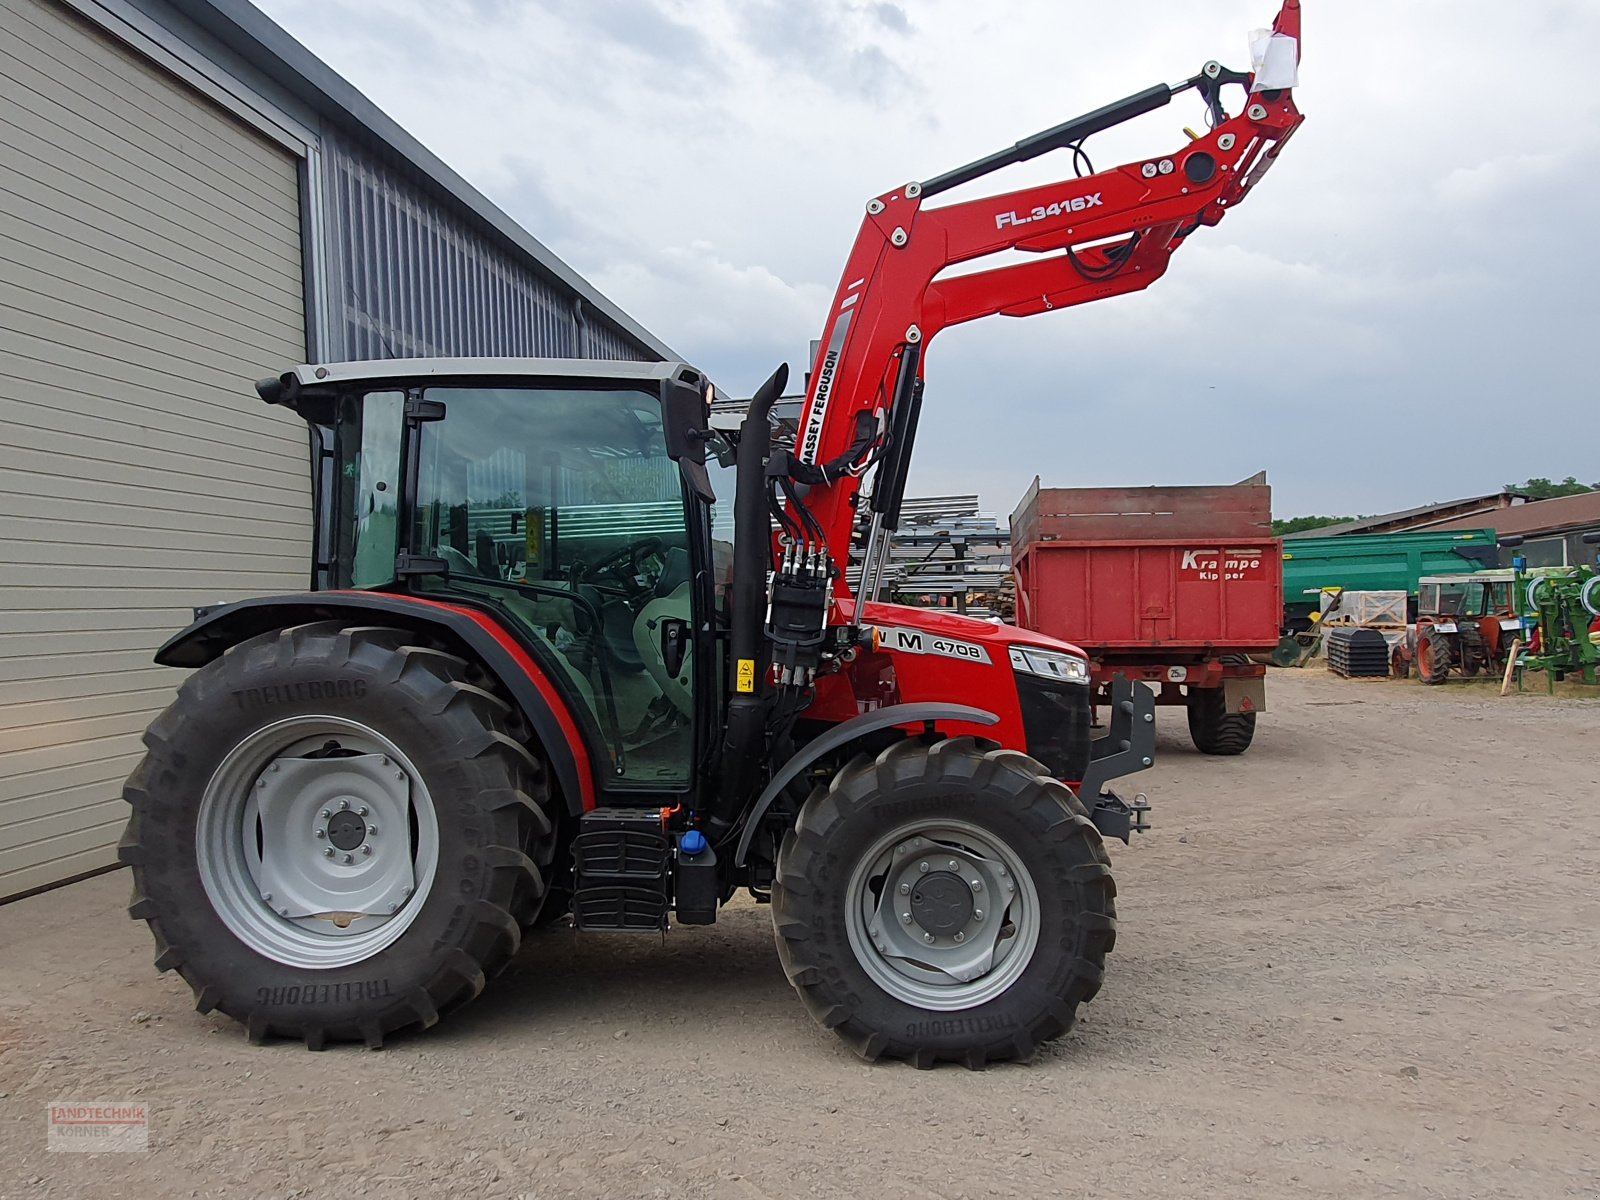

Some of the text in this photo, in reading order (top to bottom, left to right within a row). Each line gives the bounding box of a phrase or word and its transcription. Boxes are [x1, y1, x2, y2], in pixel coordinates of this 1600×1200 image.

[995, 192, 1103, 229] FL.3416X
[813, 350, 838, 415] FERGUSON
[1199, 572, 1245, 580] Kipper
[897, 632, 922, 650] M
[933, 640, 981, 658] 4708
[231, 679, 368, 713] TRELLEBORG
[256, 978, 395, 1006] TRELLEBORG
